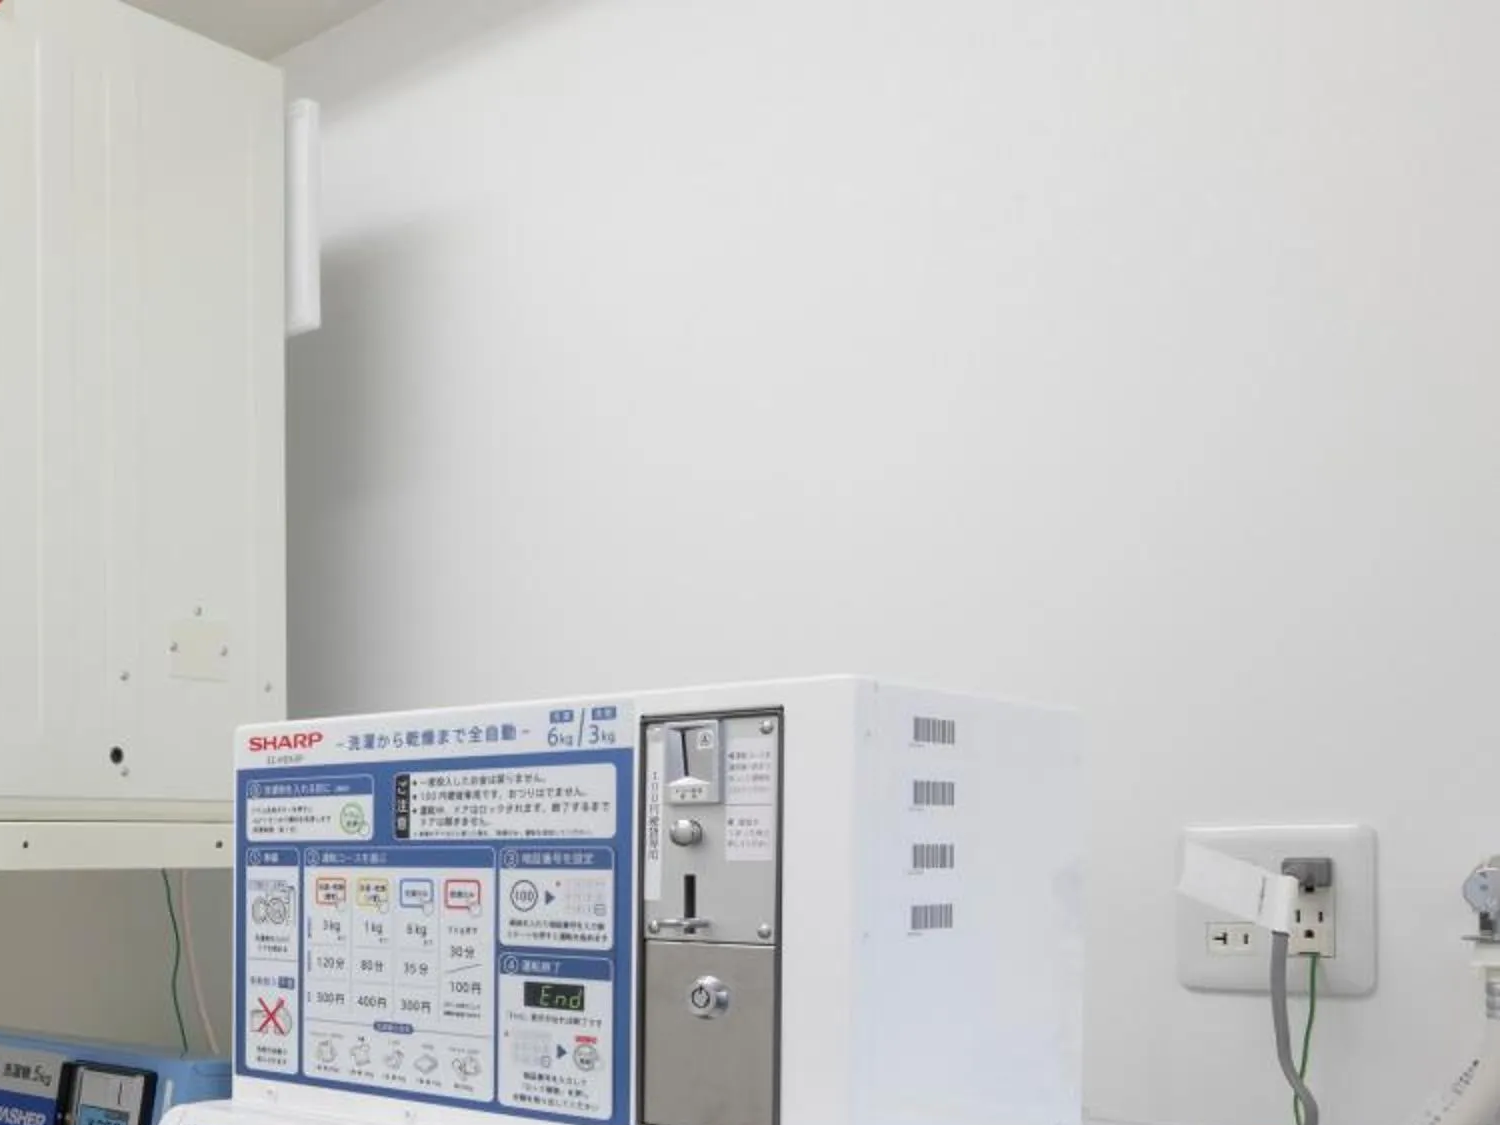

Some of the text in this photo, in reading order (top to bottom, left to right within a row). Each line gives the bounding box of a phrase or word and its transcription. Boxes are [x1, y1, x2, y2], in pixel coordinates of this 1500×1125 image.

[249, 732, 324, 752] SHARP
[547, 723, 616, 748] 6kg 3kg
[449, 981, 482, 996] 100円
[539, 984, 582, 1010] End
[357, 995, 387, 1009] 400円
